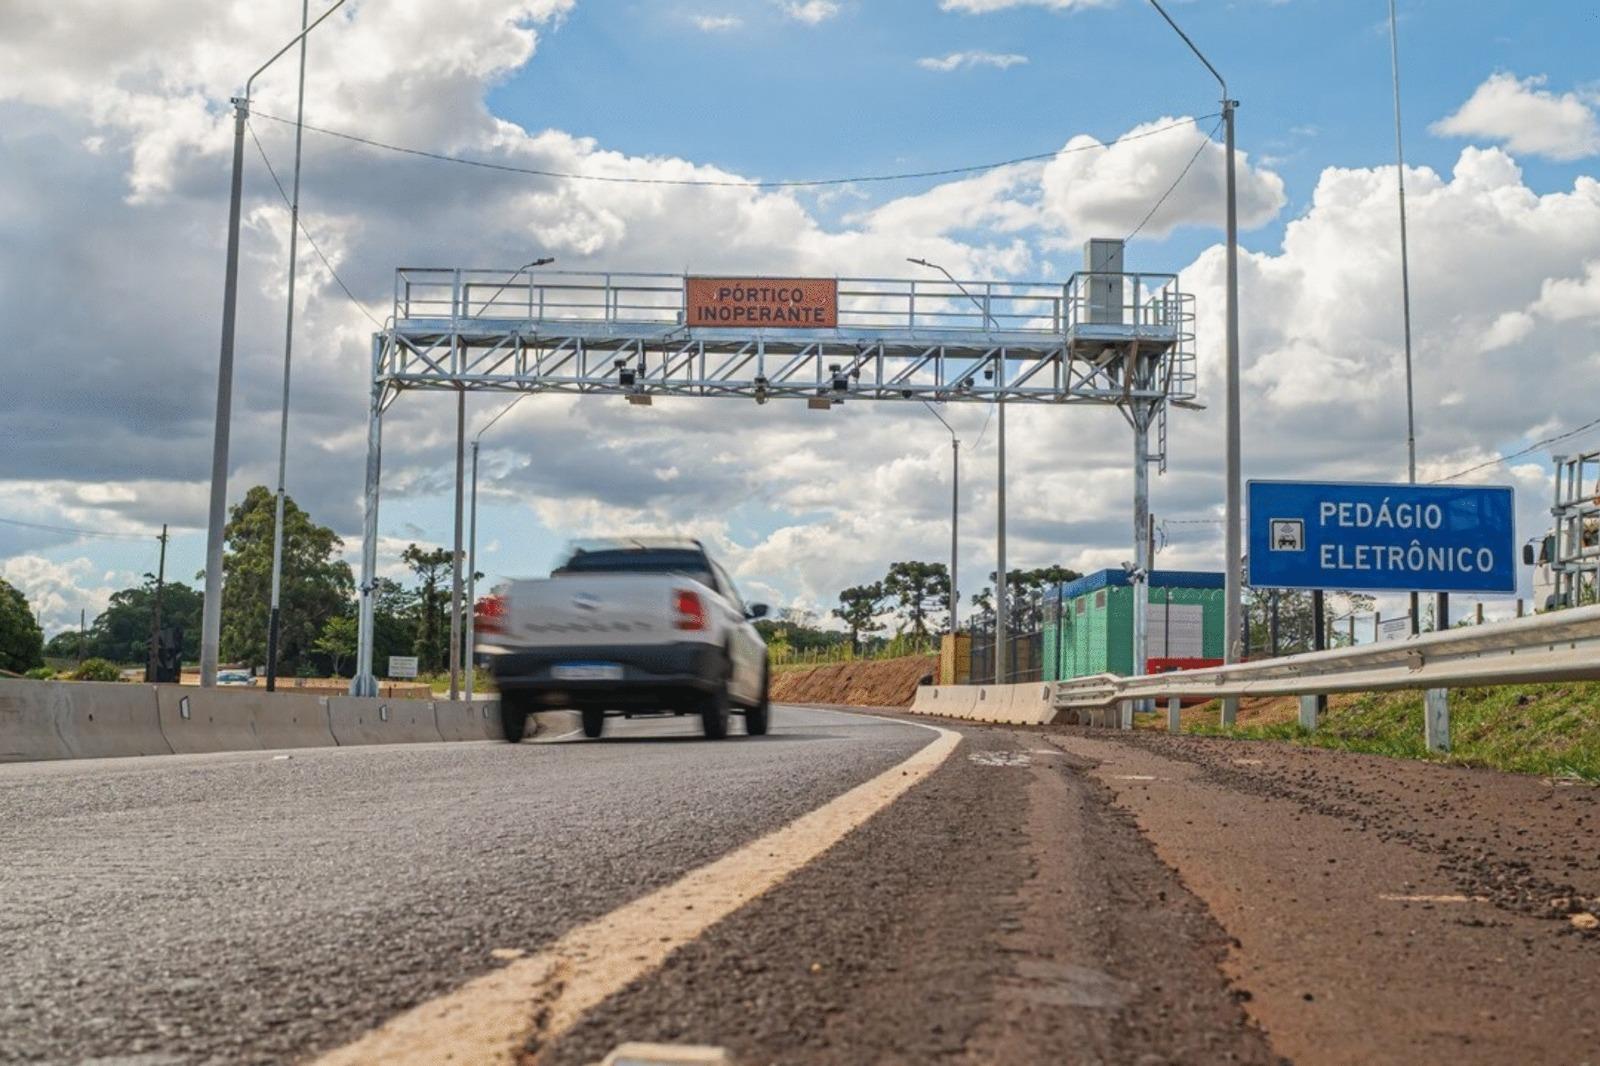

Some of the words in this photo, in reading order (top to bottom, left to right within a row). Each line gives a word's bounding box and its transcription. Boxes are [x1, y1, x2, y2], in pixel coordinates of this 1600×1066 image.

[719, 284, 804, 303] PÓRTICO
[698, 306, 825, 322] INOPERANTE
[1320, 497, 1442, 529] PEDÁGIO
[1320, 539, 1494, 572] ELETRÔNICO
